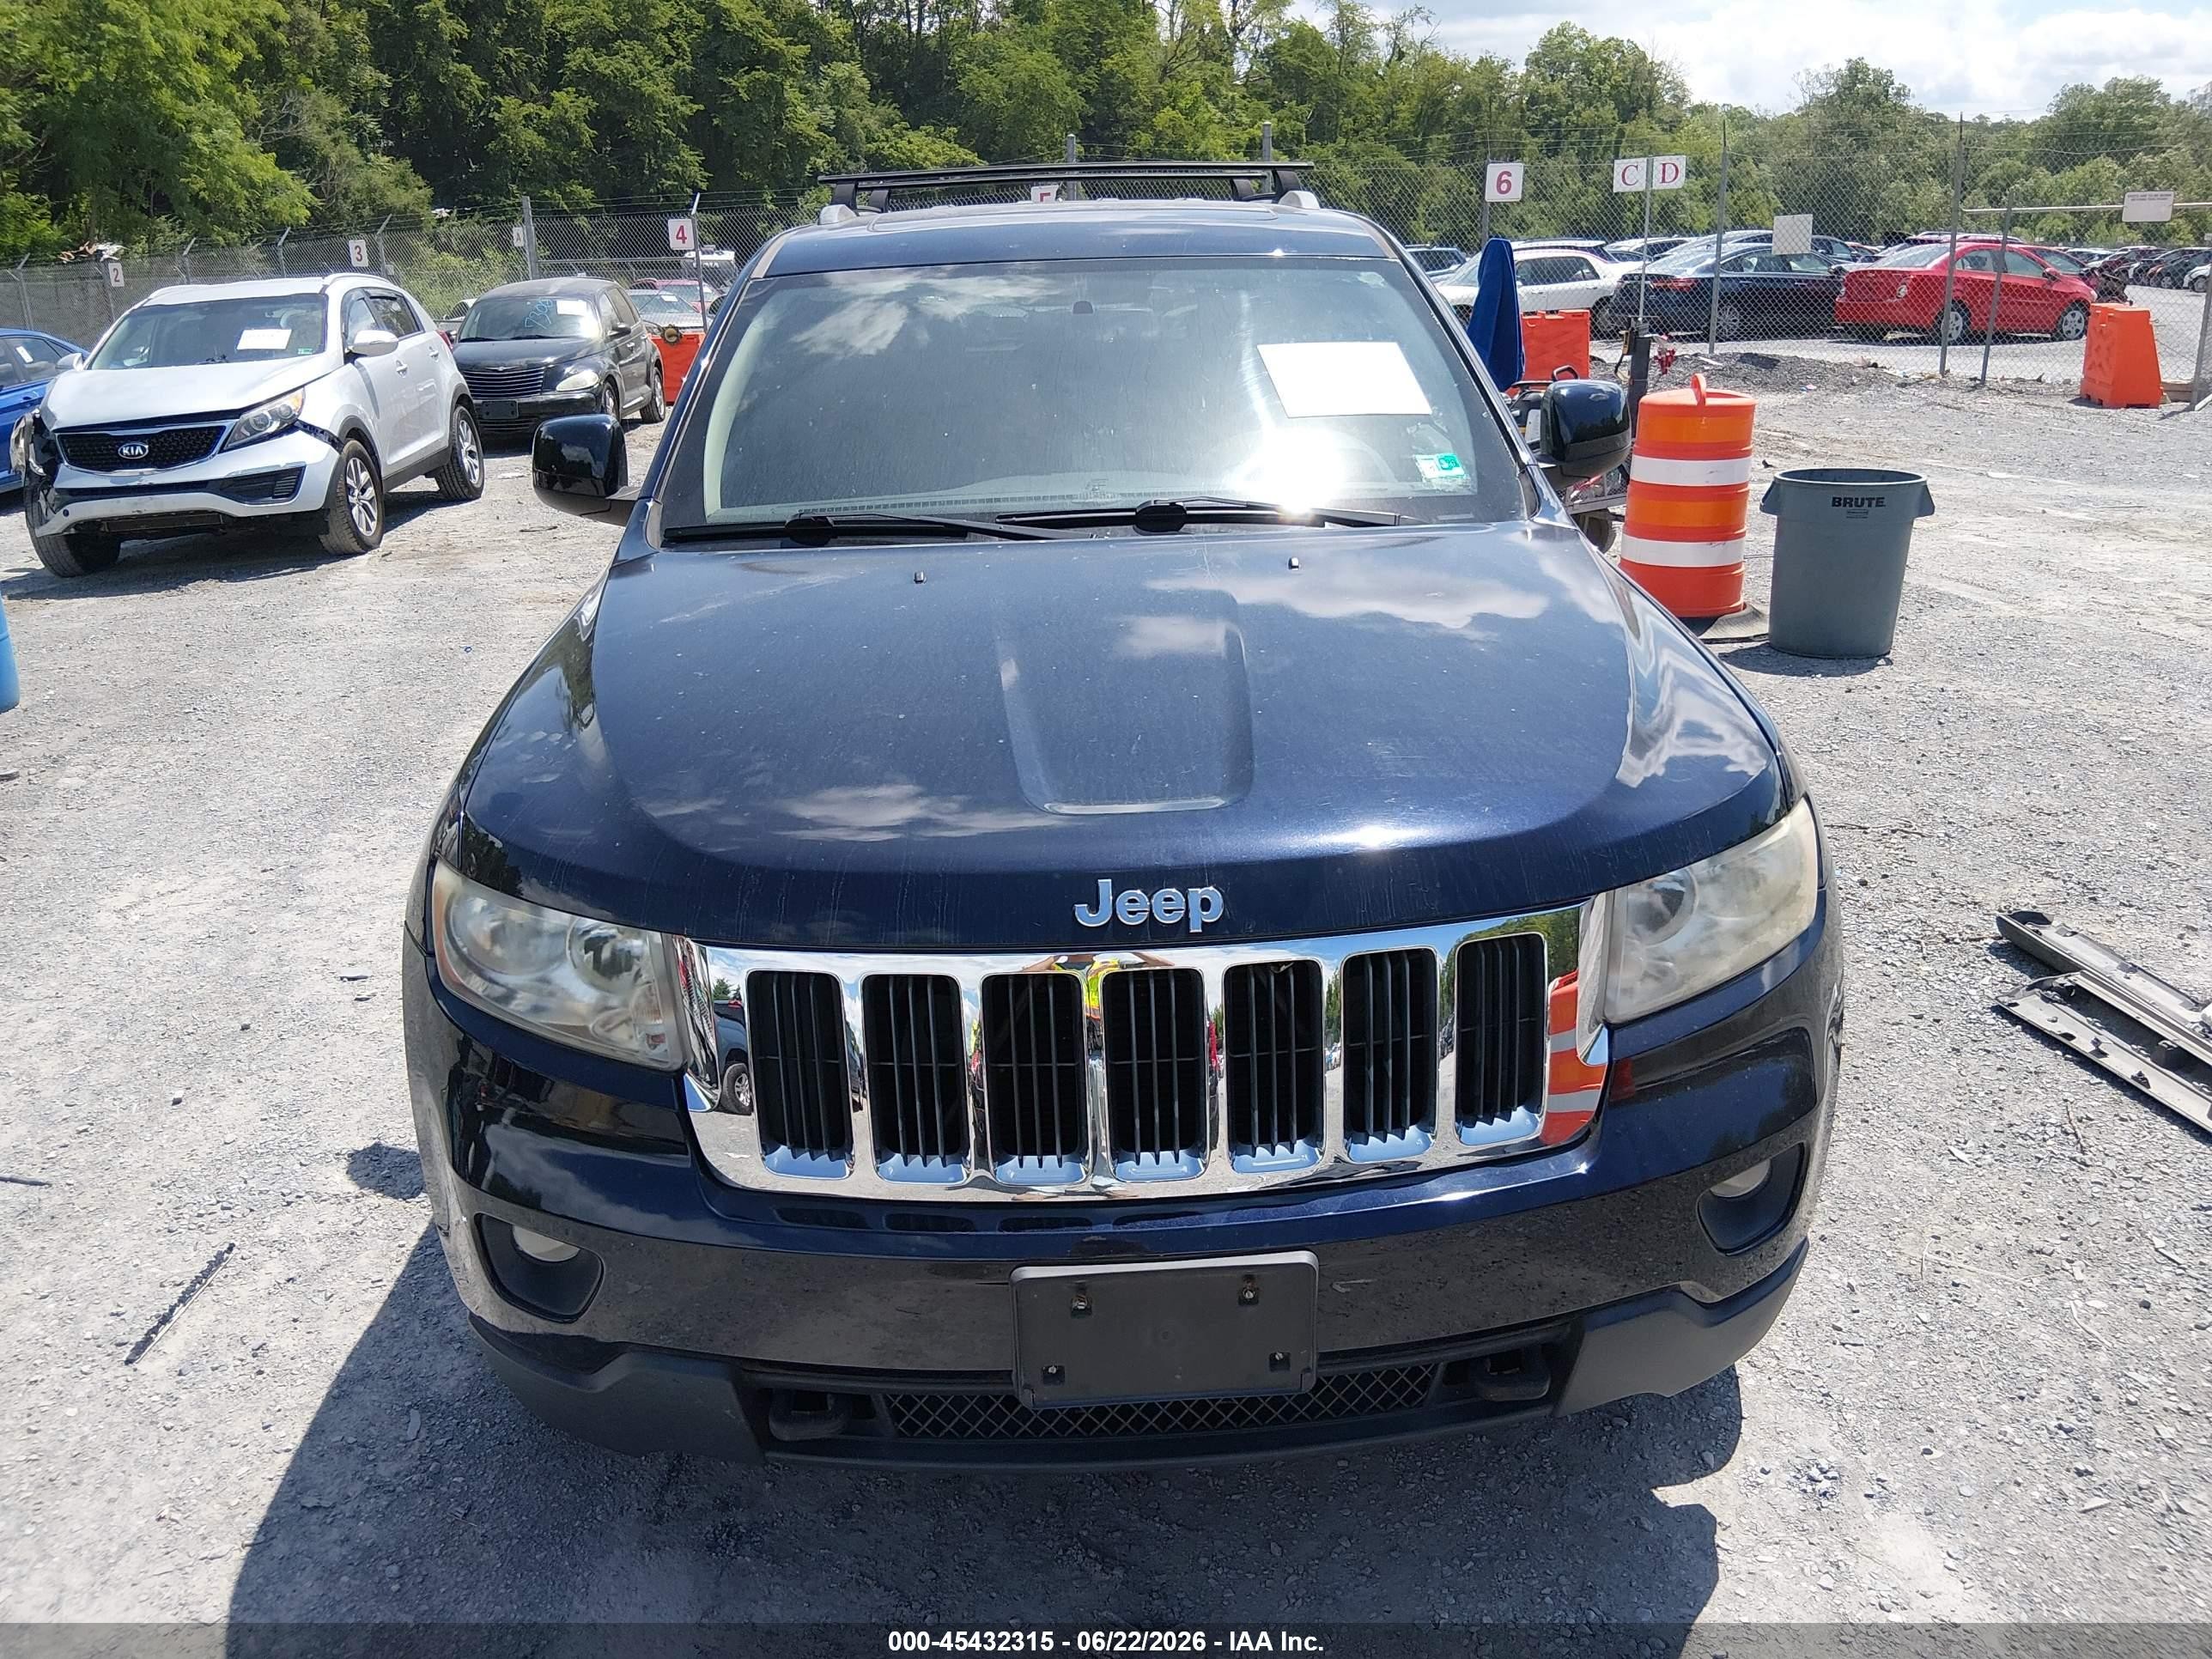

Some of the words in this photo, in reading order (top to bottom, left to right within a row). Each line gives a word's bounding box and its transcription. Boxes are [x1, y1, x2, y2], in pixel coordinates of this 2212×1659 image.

[1495, 170, 1513, 195] 6
[1621, 164, 1639, 186] C
[1659, 162, 1680, 185] D
[675, 225, 688, 245] 4
[354, 245, 363, 262] 3
[112, 267, 120, 283] 2
[122, 446, 144, 456] KIA
[1831, 496, 1887, 508] BRUTE
[1074, 878, 1224, 933] Jeep
